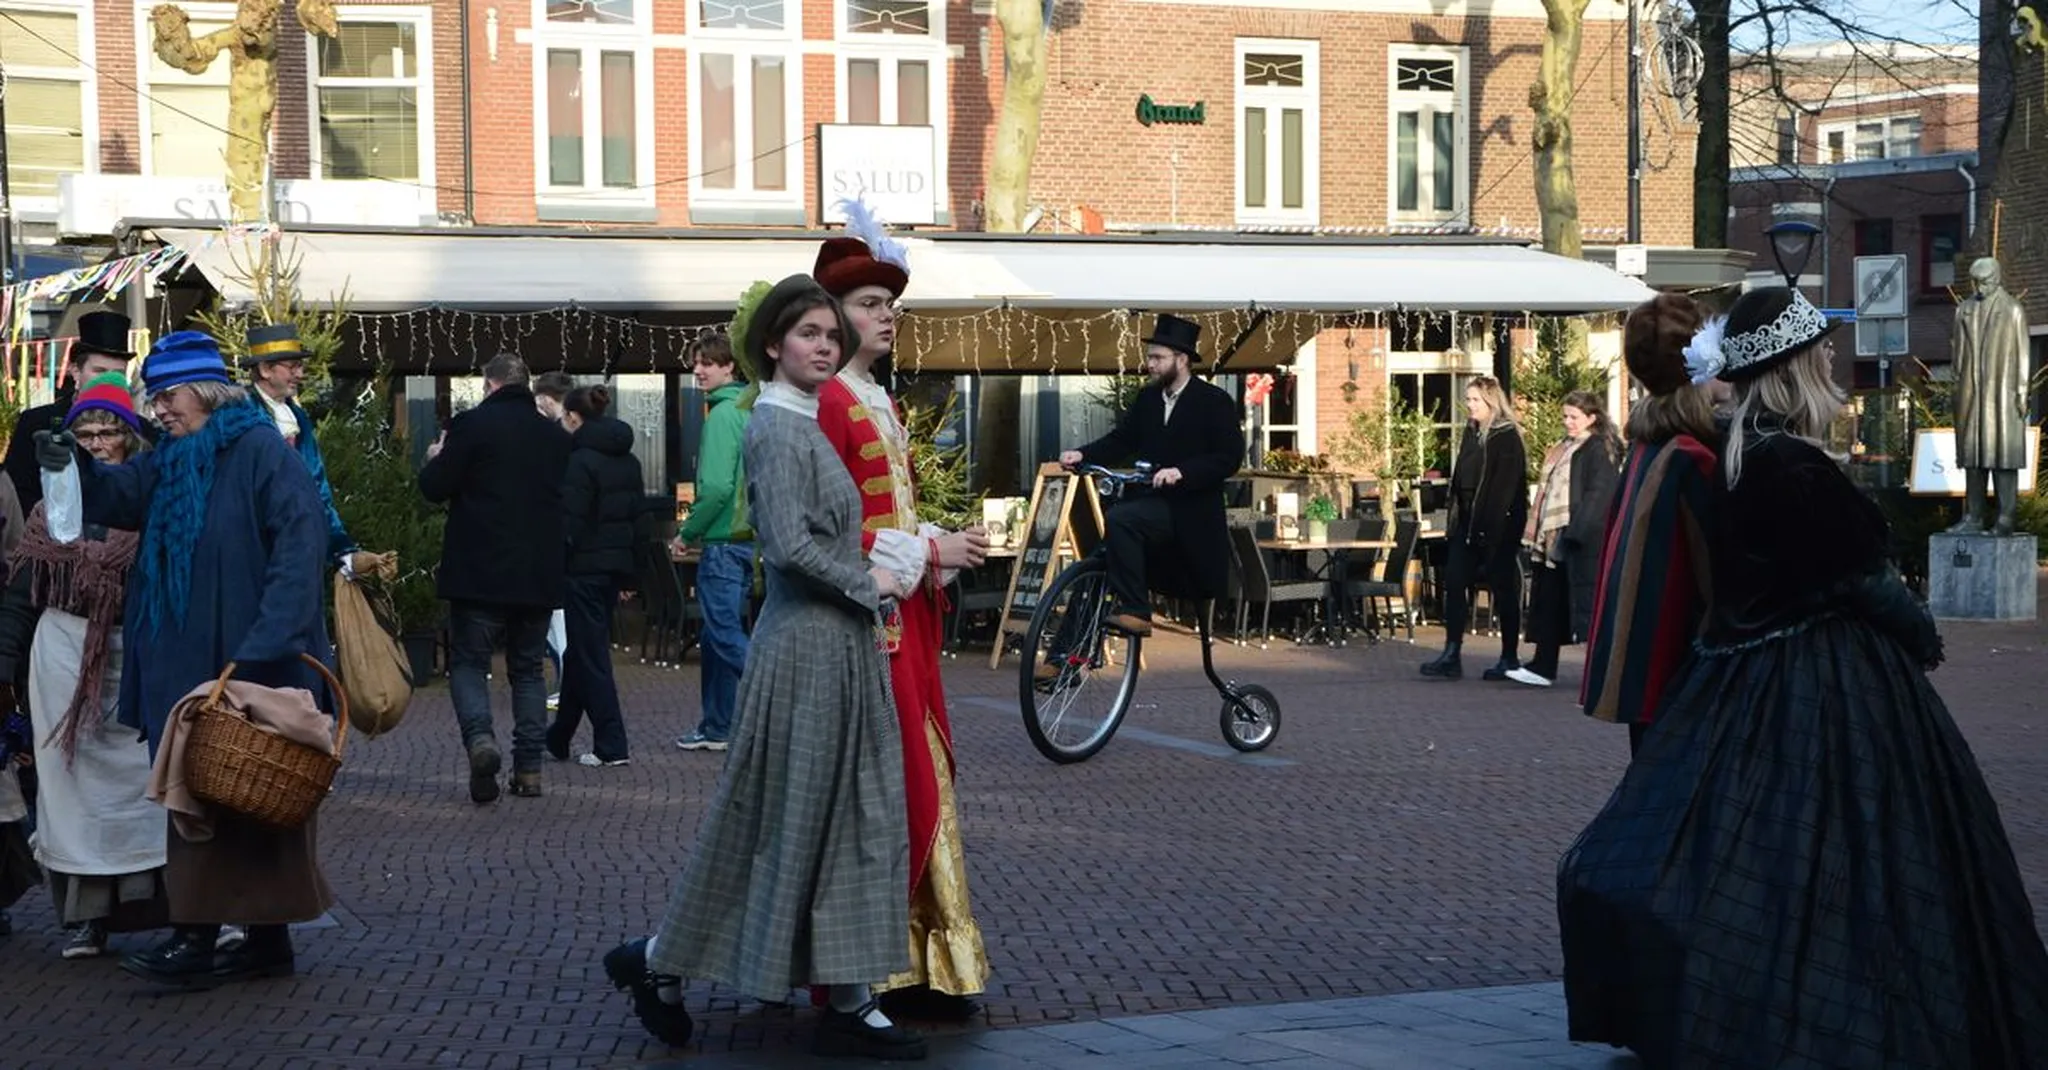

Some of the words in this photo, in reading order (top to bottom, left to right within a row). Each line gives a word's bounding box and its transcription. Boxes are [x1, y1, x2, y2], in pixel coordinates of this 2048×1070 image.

[1135, 93, 1206, 127] Brand
[833, 169, 925, 194] SALUD
[174, 197, 312, 223] SAD
